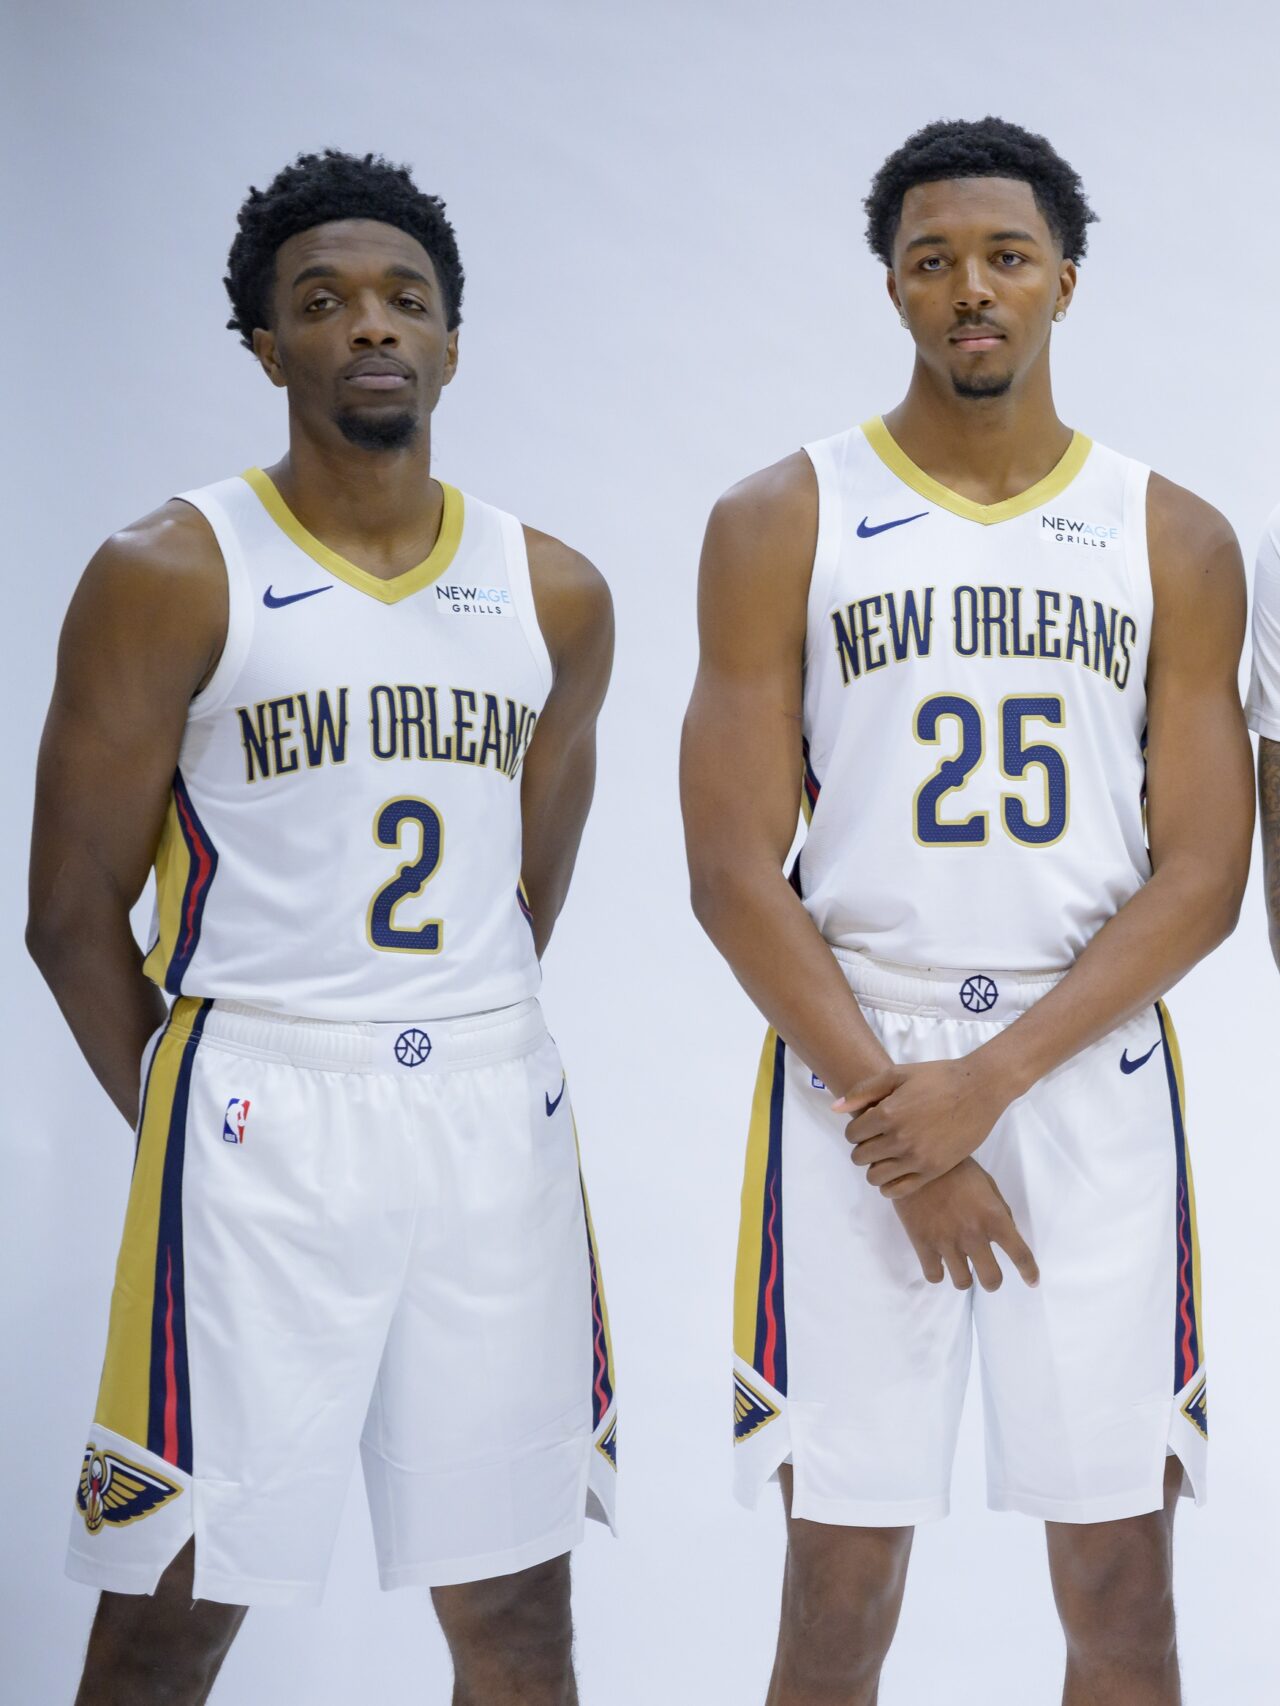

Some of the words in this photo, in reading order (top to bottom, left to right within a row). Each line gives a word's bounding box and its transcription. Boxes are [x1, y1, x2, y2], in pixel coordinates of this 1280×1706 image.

[1055, 533, 1107, 549] GRILLS
[436, 585, 510, 604] NEWAGE
[452, 604, 502, 615] GRILLS
[830, 586, 936, 688] NEW
[950, 585, 1138, 692] ORLEANS
[235, 686, 351, 784] NEW
[912, 691, 1070, 848] 25
[366, 795, 445, 954] 2
